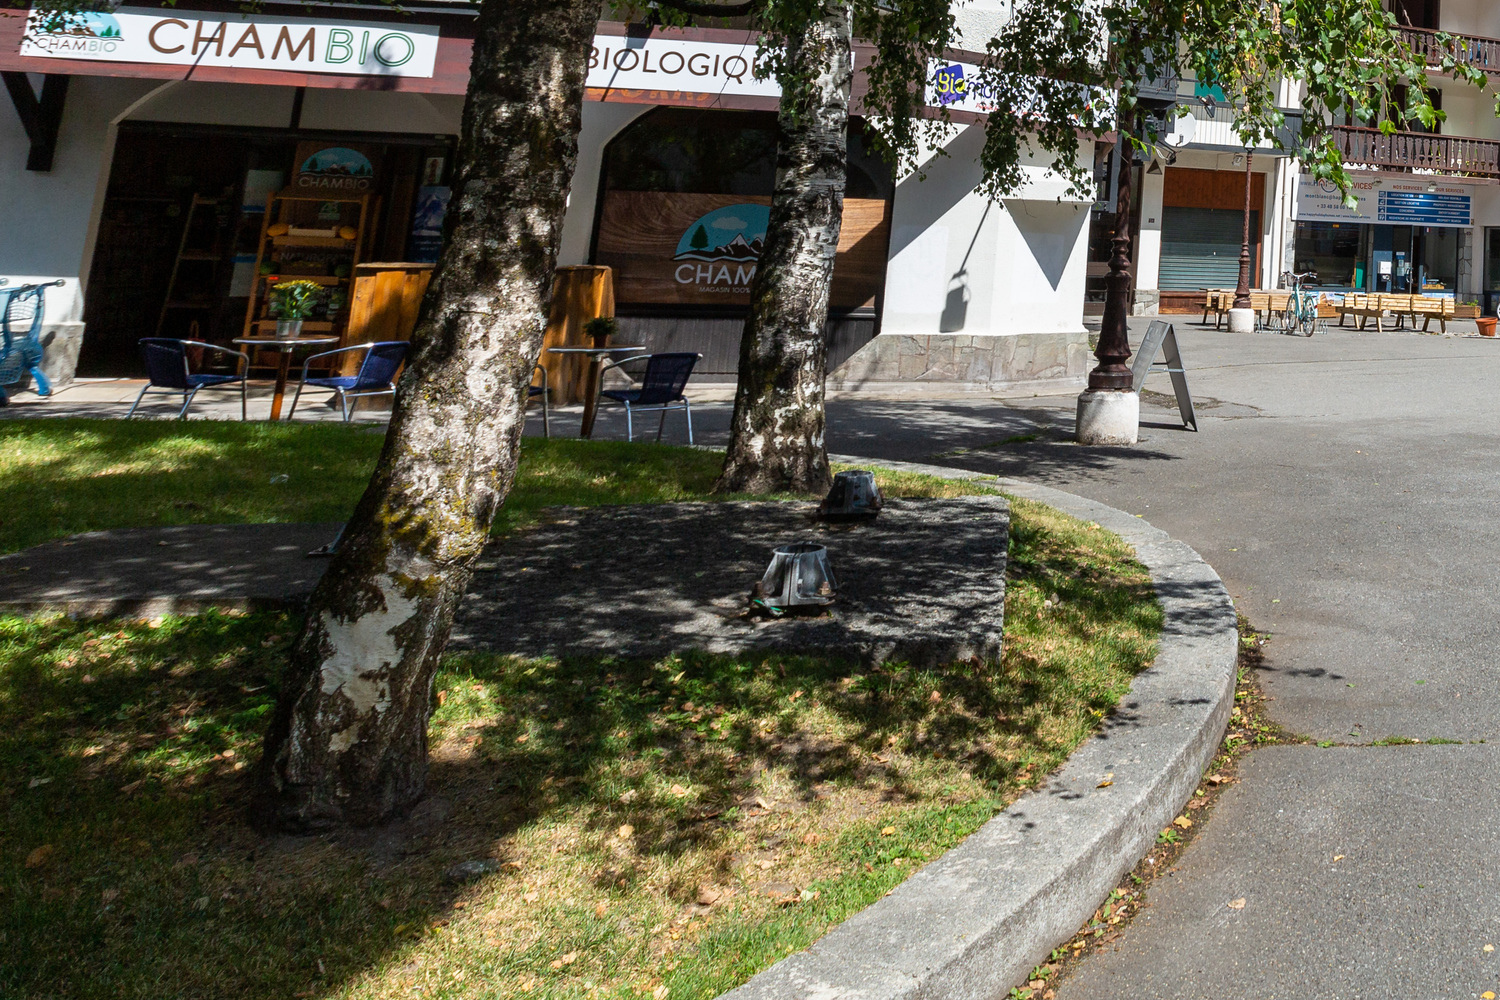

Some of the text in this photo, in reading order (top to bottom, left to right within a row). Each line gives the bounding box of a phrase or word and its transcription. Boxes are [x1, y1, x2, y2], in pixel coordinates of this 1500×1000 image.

[36, 37, 117, 53] CHAMBIO
[148, 18, 415, 67] CHAMBIO
[299, 176, 370, 190] CHAMBIO
